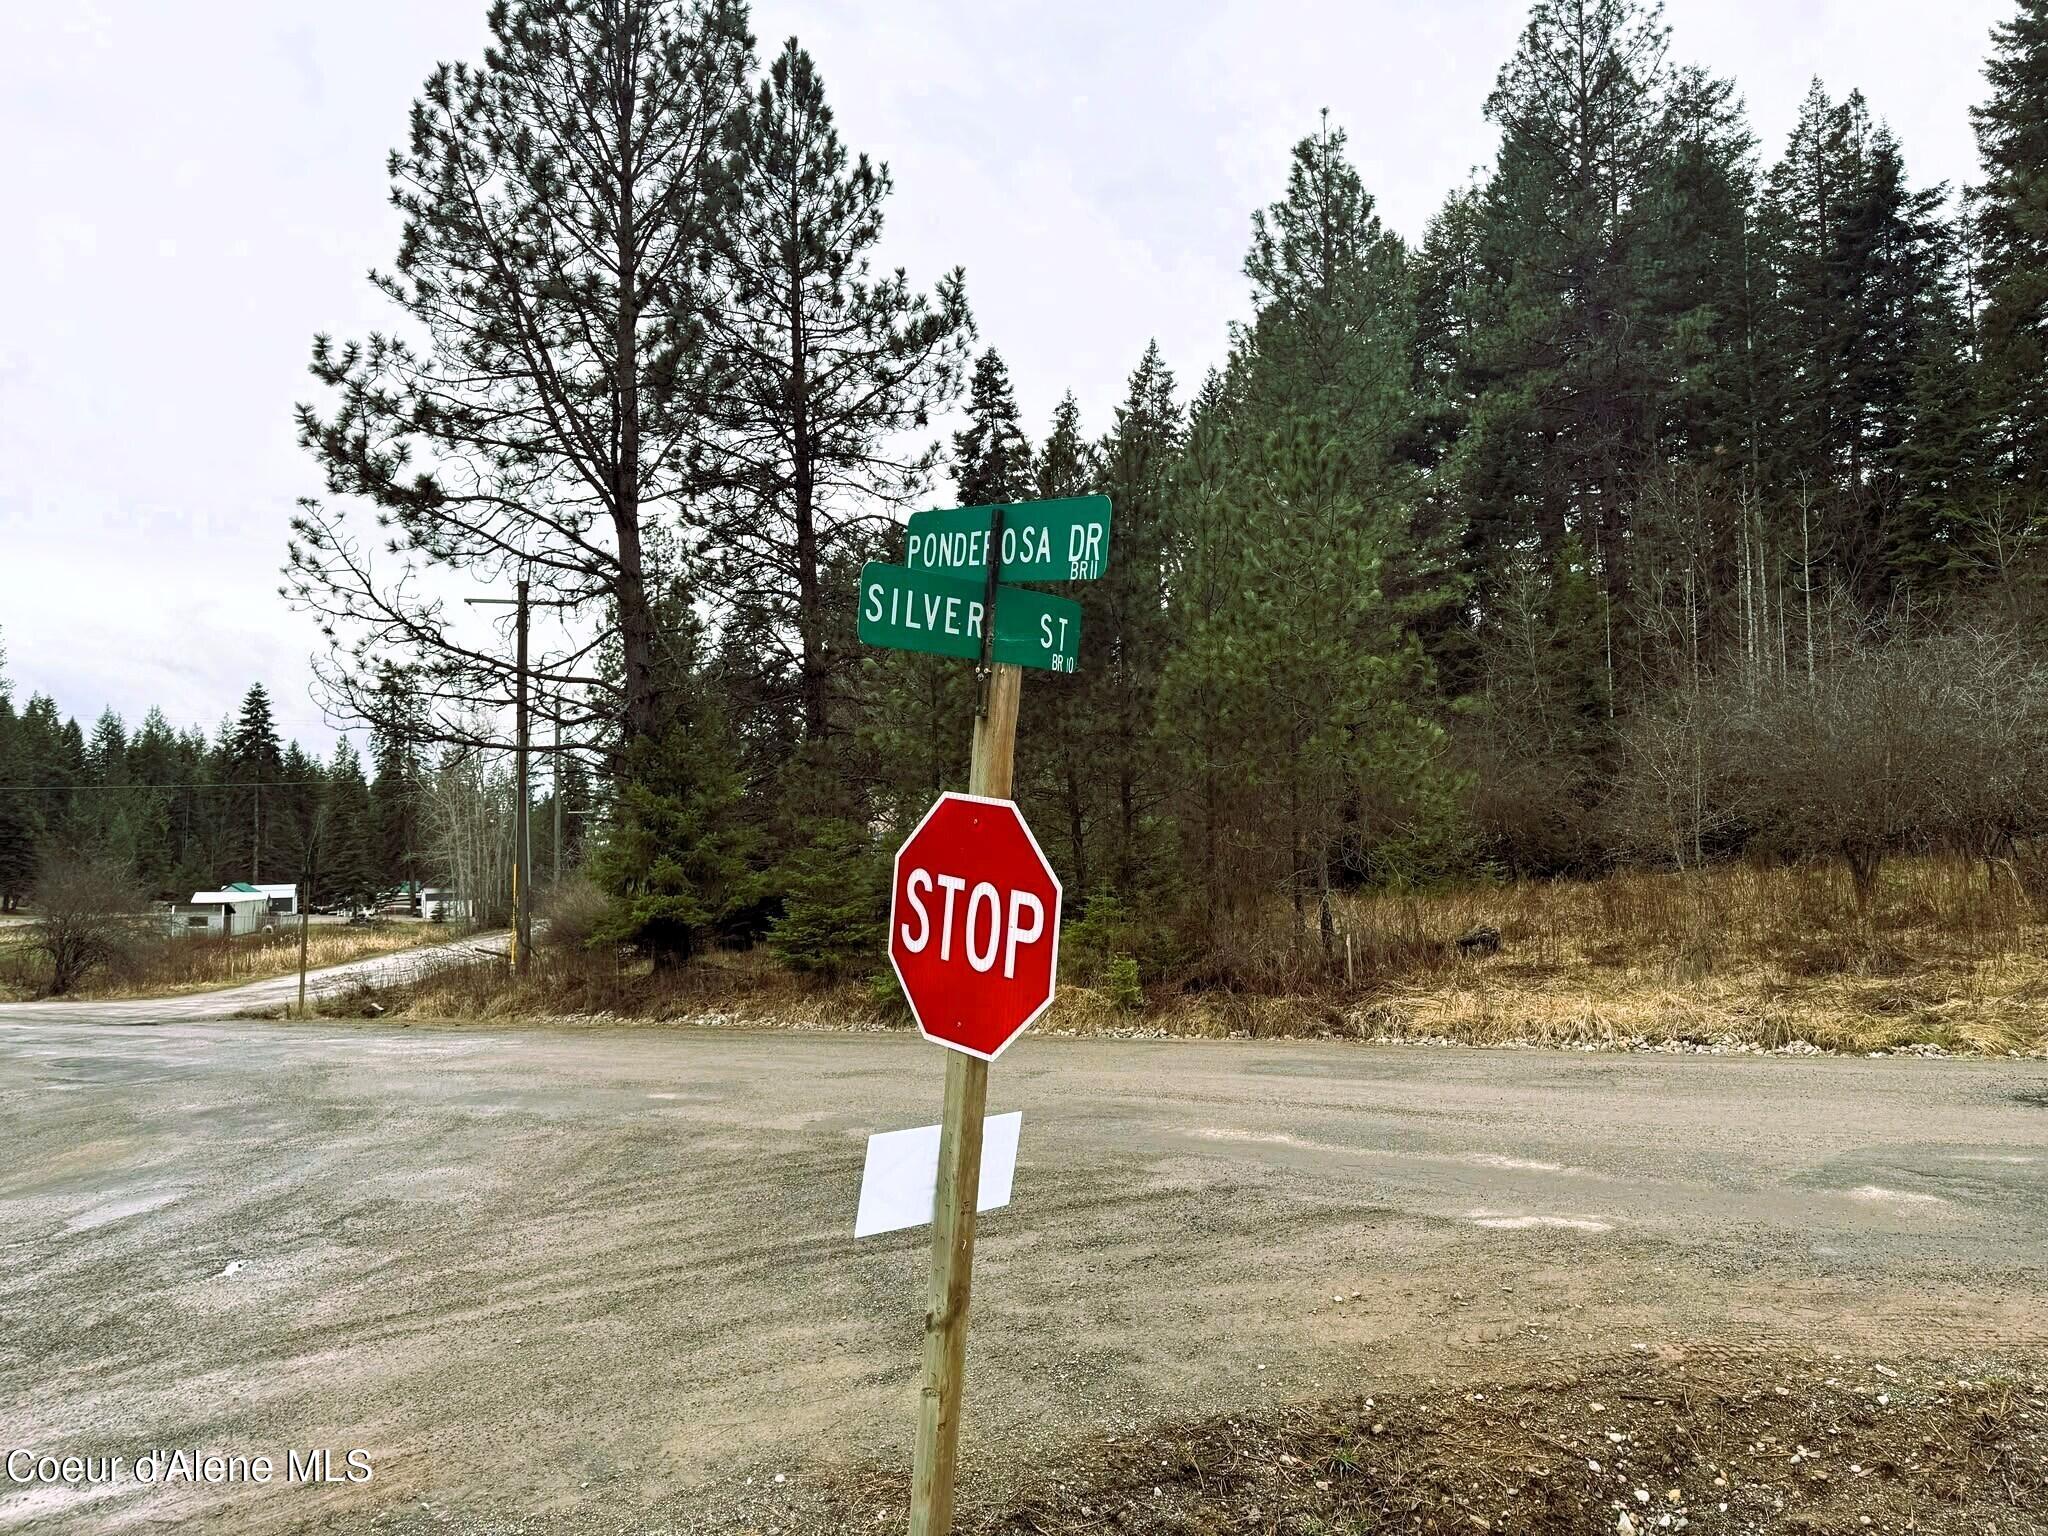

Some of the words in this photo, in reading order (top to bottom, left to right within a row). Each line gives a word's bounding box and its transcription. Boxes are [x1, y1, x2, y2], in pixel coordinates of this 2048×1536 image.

[1068, 522, 1103, 562] DR
[865, 583, 985, 638] SILVER
[1040, 613, 1068, 651] ST
[901, 868, 1045, 979] STOP
